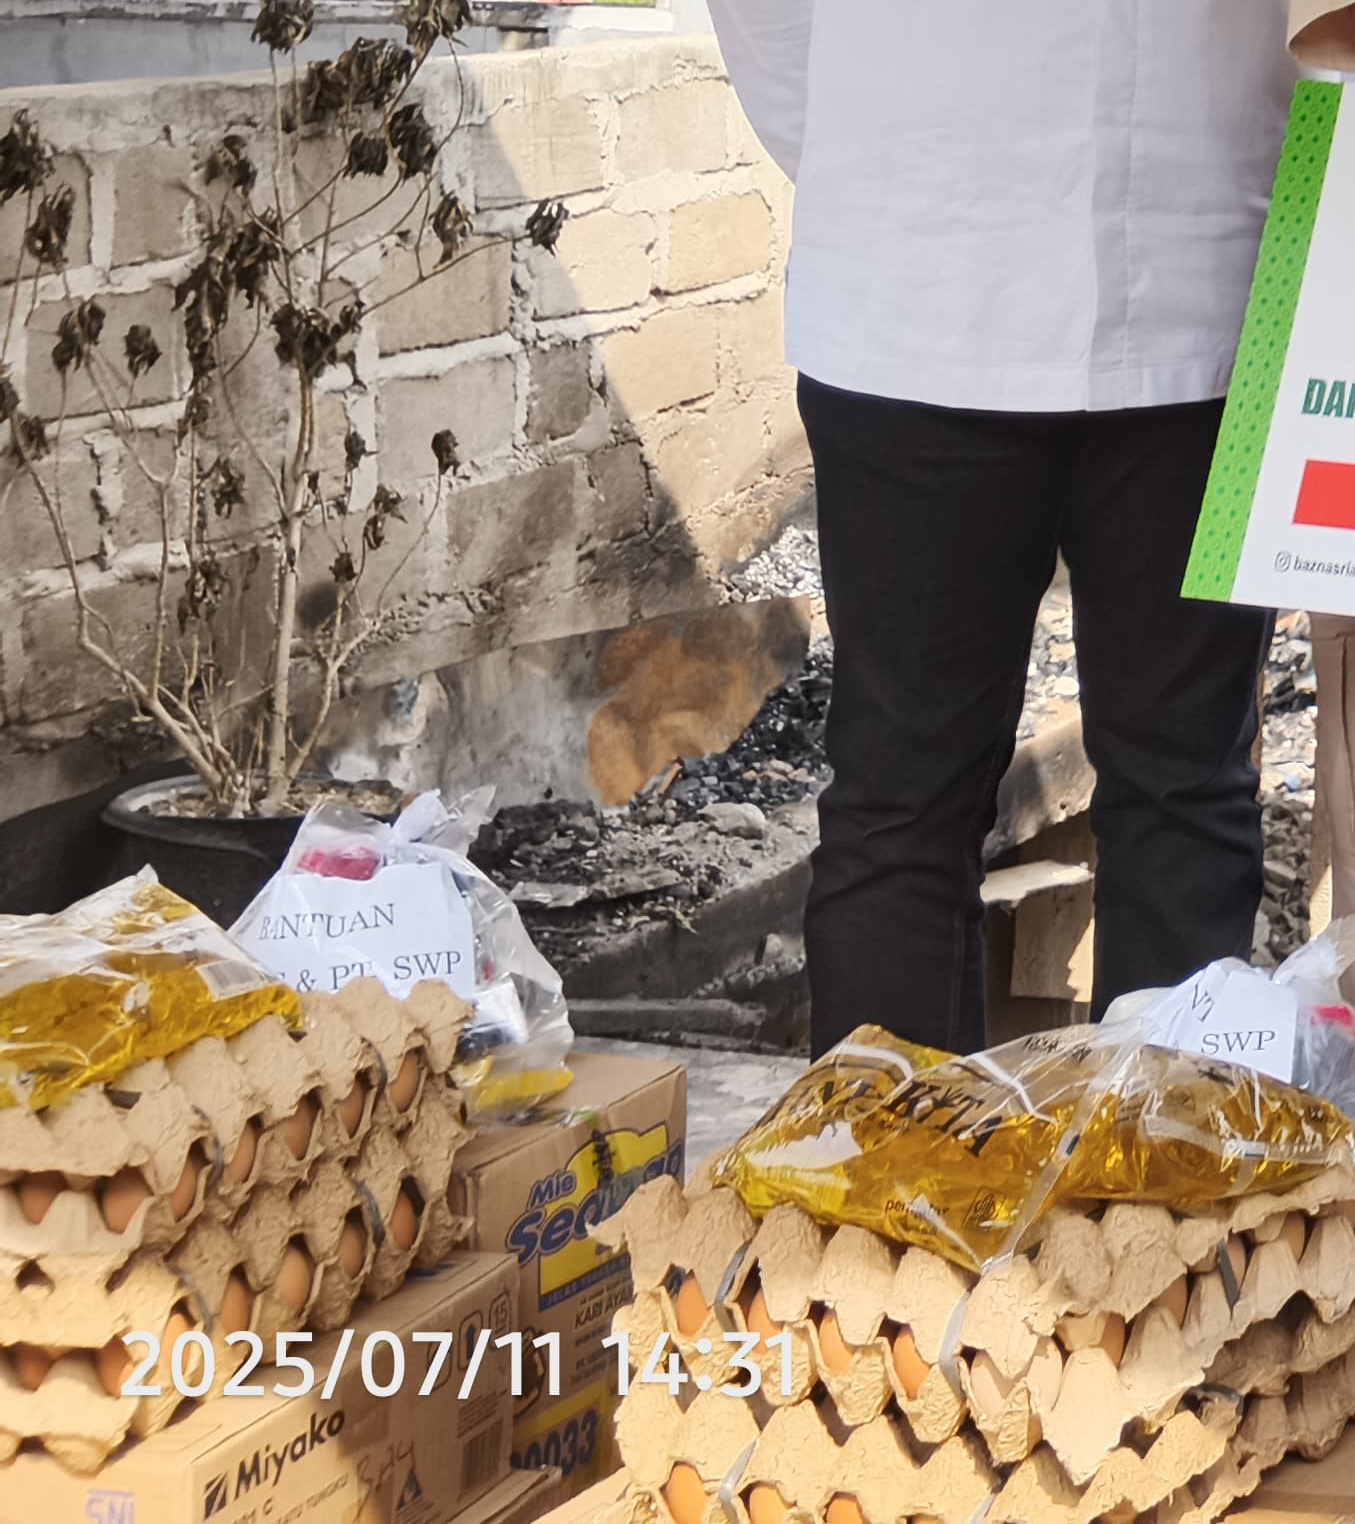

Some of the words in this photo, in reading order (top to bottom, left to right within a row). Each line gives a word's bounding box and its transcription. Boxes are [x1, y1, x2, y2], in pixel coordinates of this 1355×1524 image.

[393, 950, 462, 981] SWP
[1201, 1030, 1276, 1056] SWP
[525, 1167, 578, 1211] Mie
[233, 1408, 346, 1501] Miyako
